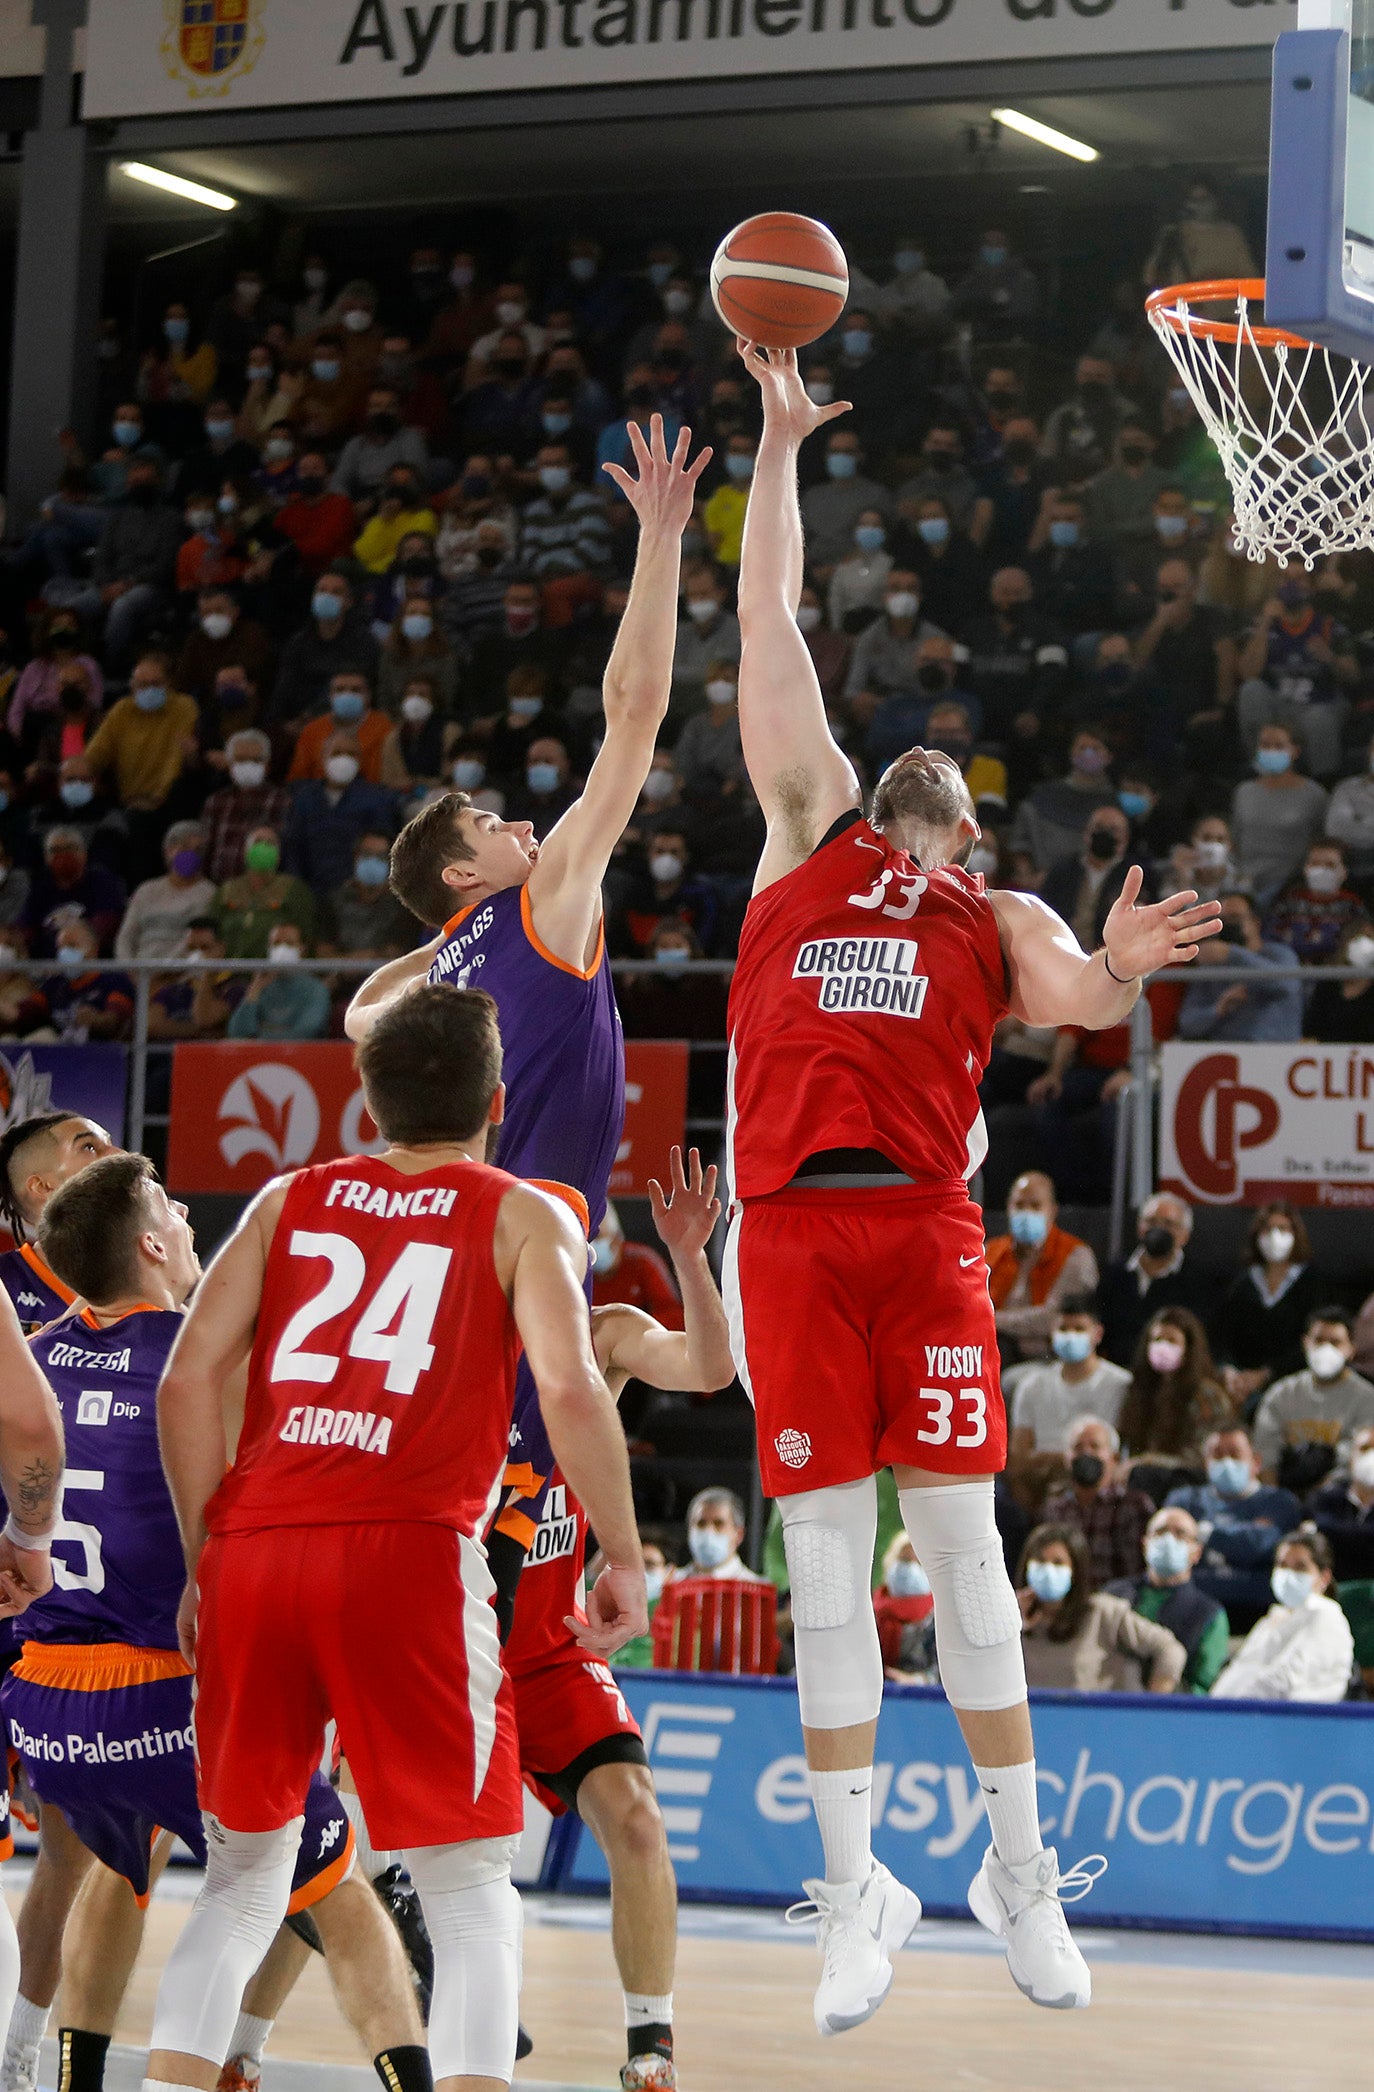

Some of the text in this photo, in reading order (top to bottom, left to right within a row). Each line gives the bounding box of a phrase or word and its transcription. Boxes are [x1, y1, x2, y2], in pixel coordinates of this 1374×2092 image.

[847, 869, 929, 920] 33
[797, 940, 908, 975] ORGULL
[822, 976, 926, 1013] GIRONÍ
[325, 1179, 458, 1218] FRANCH
[270, 1230, 453, 1395] 24
[47, 1342, 131, 1373] ORTEGA
[924, 1345, 983, 1378] YOSOY
[113, 1402, 140, 1419] Dip
[917, 1387, 987, 1447] 33
[279, 1406, 393, 1455] GIRONA
[779, 1446, 812, 1462] GIRONA
[528, 1517, 575, 1561] ONÍ
[602, 1685, 628, 1723] 7
[10, 1719, 65, 1762] Diario
[755, 1748, 1374, 1875] esyharge
